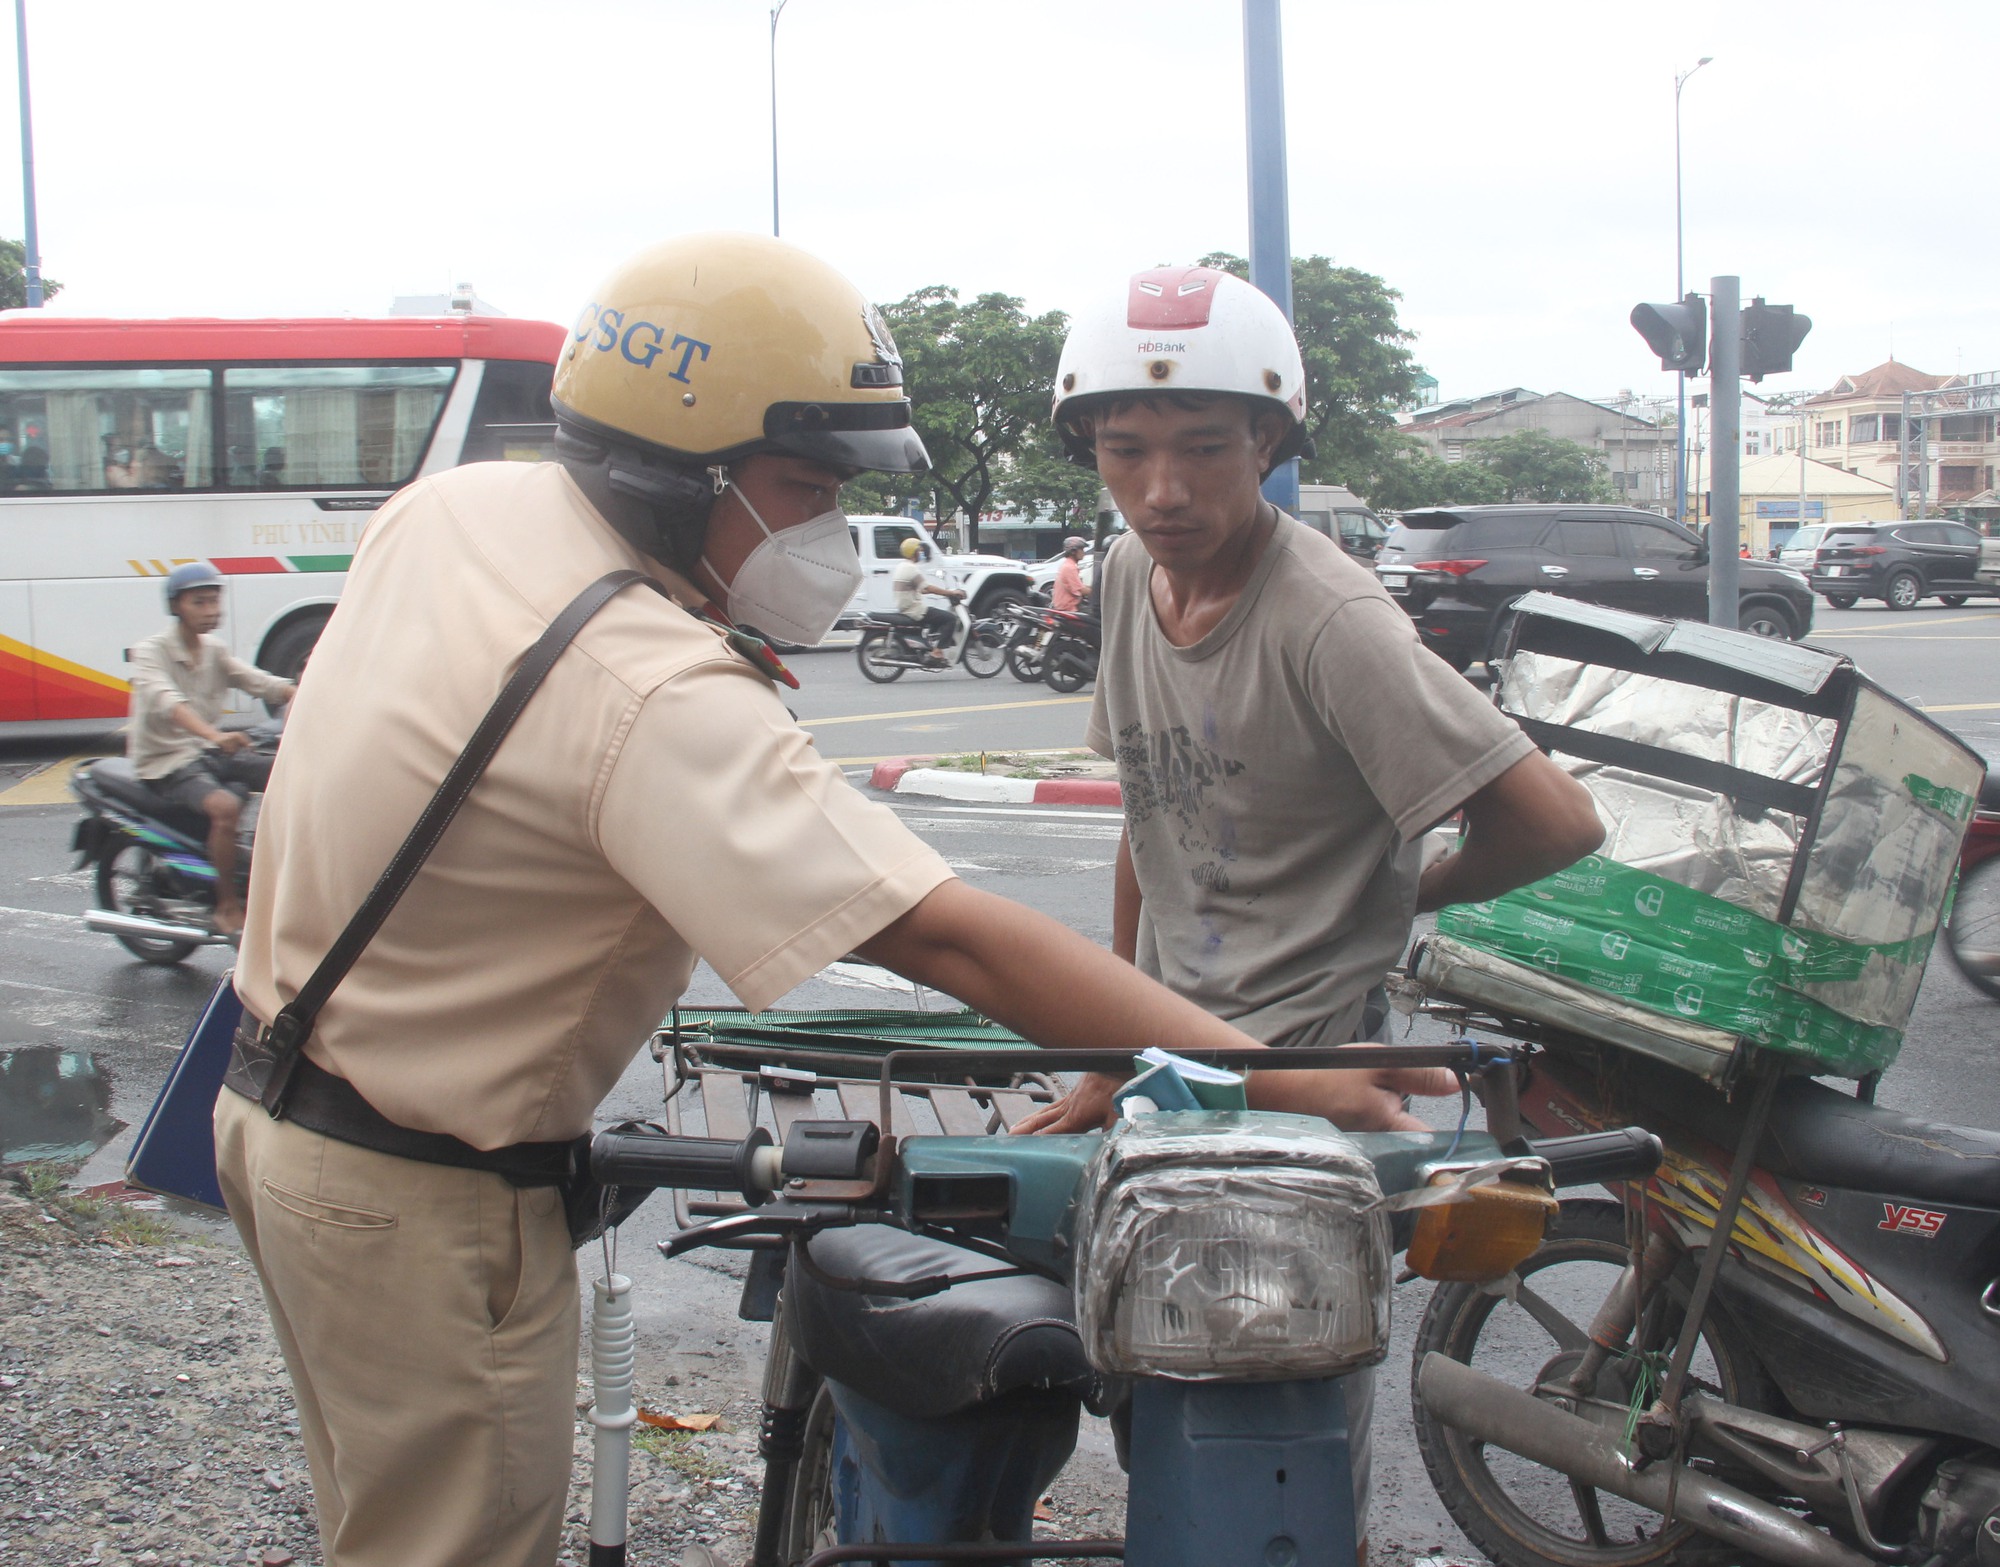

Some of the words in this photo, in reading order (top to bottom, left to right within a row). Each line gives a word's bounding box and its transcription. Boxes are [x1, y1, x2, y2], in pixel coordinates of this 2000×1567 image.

[573, 302, 711, 384] CSGT
[1137, 342, 1186, 353] HDBank
[1878, 1203, 1947, 1231] YSS
